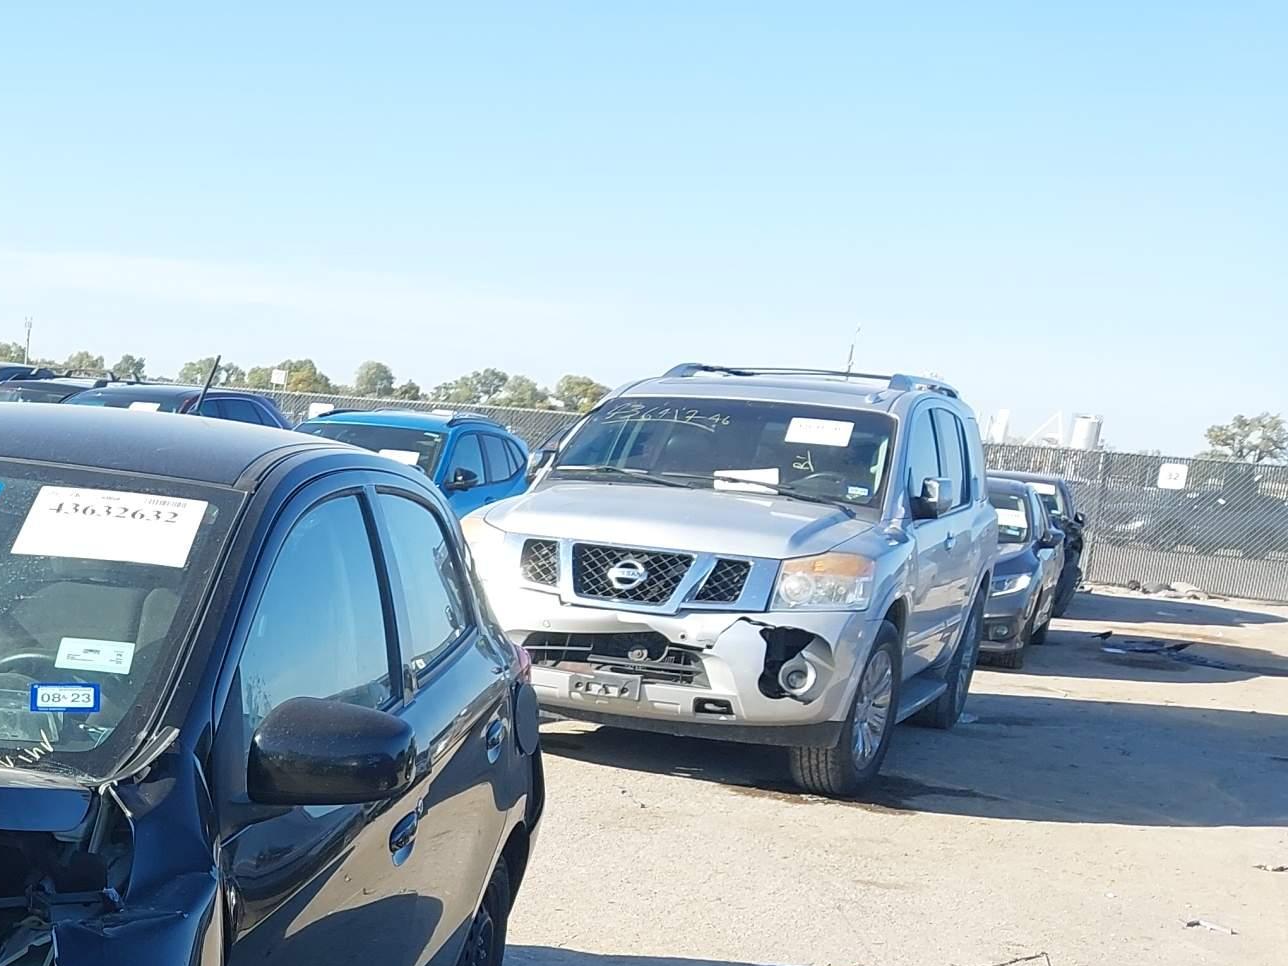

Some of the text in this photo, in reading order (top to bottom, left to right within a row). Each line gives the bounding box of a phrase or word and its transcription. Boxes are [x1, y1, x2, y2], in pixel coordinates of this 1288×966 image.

[48, 502, 179, 524] 43632632
[41, 692, 91, 704] 08 23
